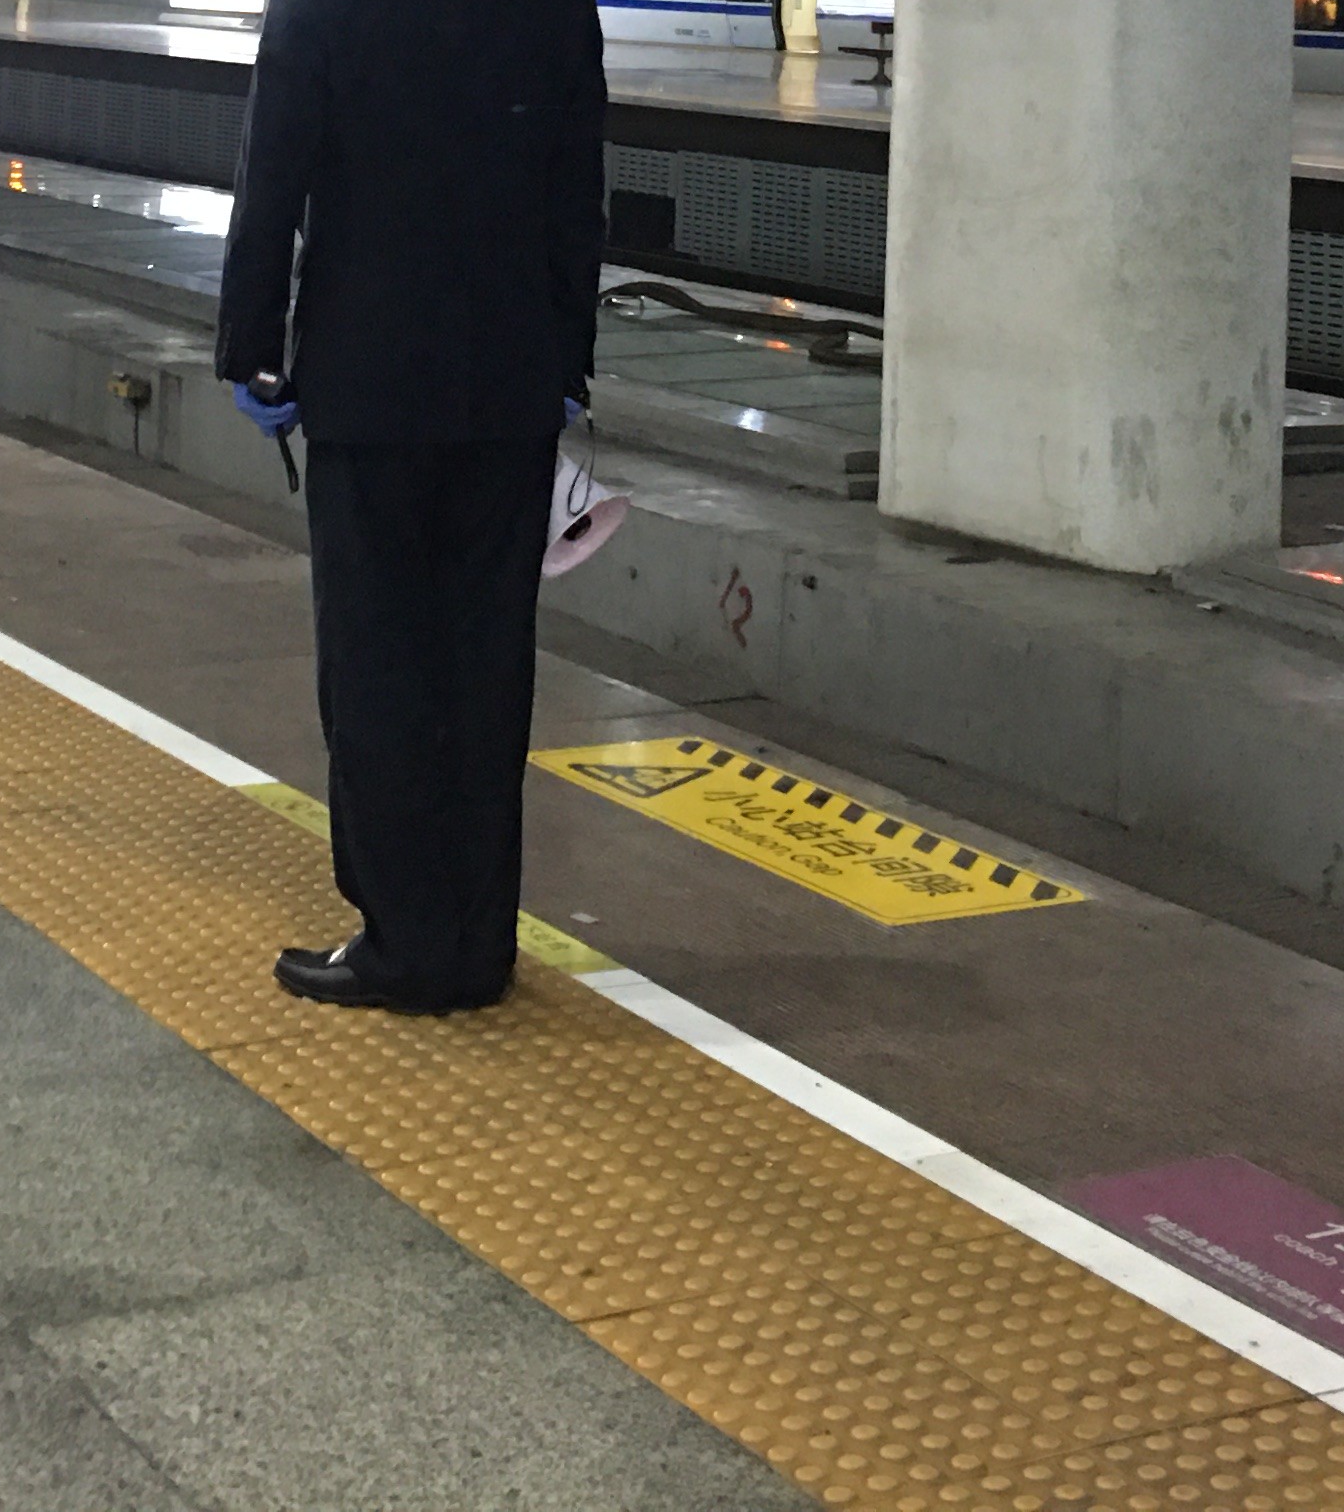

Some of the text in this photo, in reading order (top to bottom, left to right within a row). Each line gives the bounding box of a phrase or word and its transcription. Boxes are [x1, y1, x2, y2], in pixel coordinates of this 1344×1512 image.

[703, 791, 974, 897] 小心站台间隙
